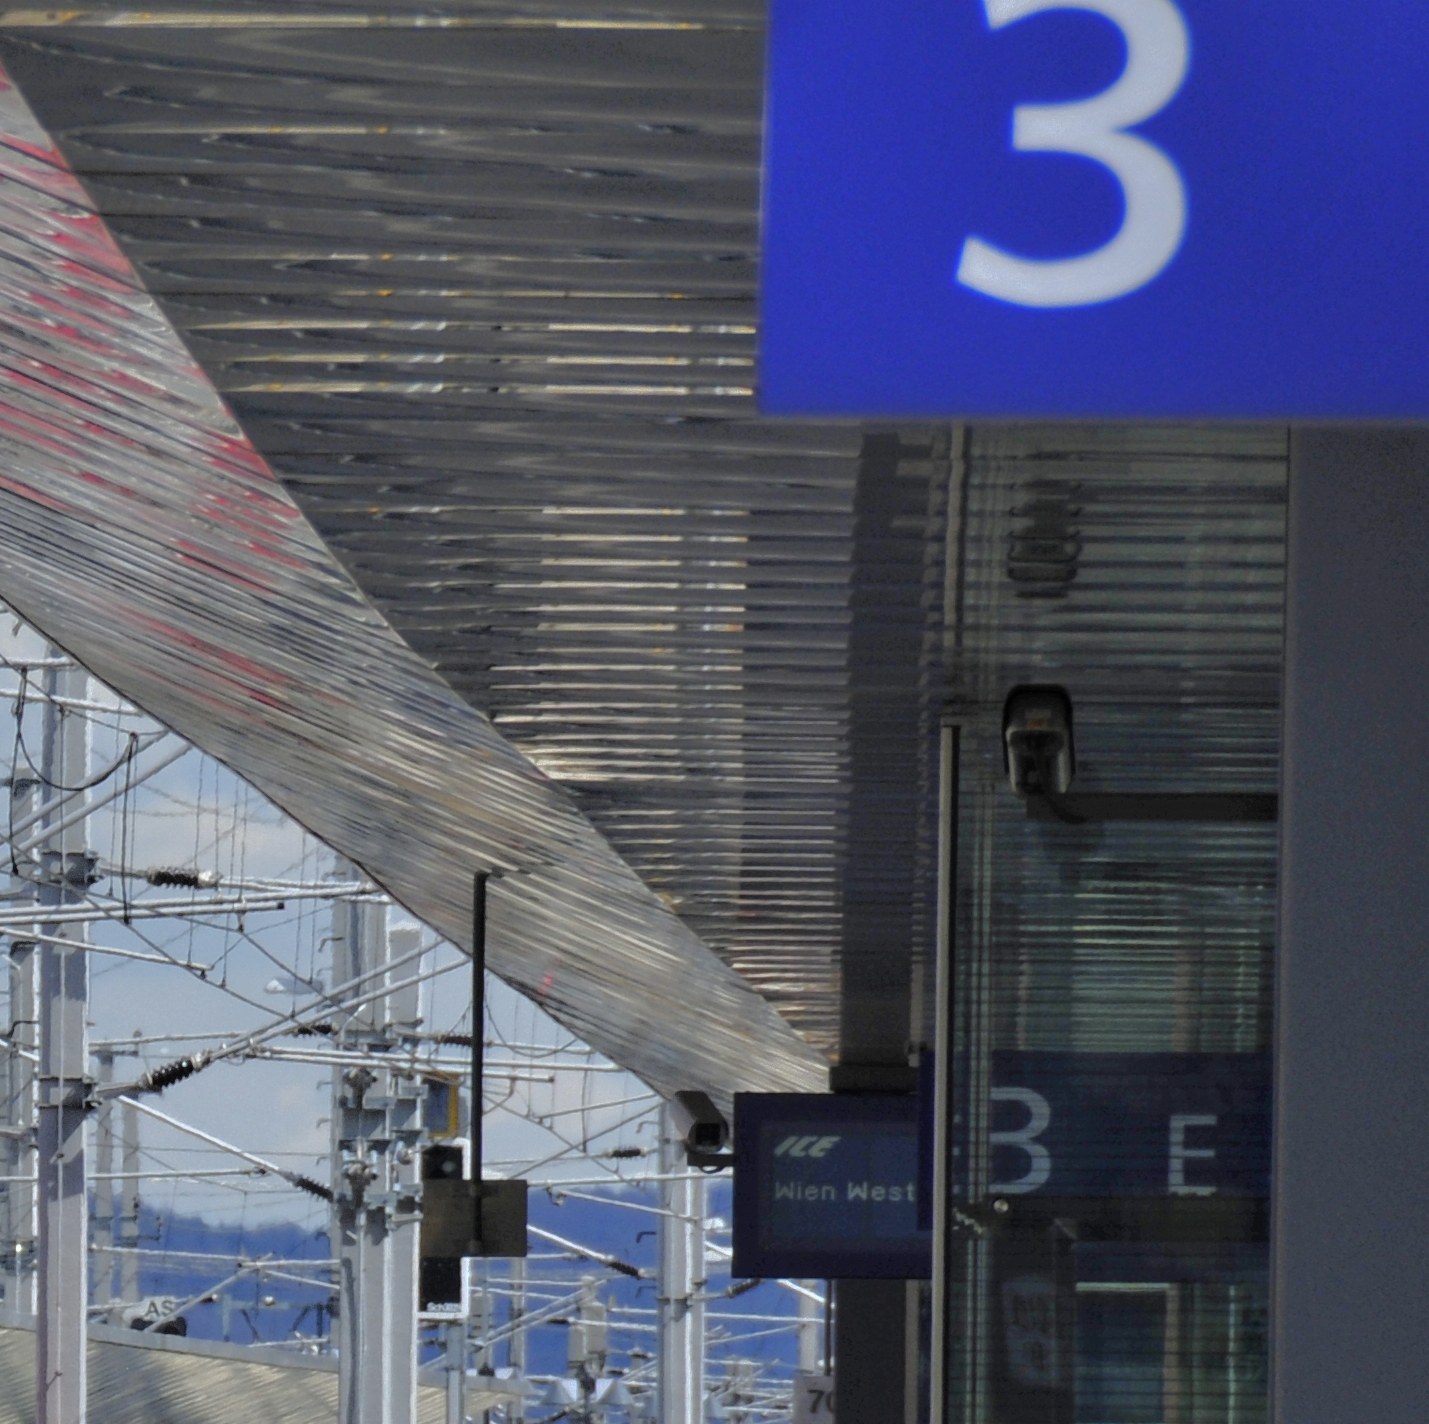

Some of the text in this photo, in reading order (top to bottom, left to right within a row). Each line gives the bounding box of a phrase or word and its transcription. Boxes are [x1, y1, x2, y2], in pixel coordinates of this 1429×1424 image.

[954, 0, 1189, 309] 3
[774, 1135, 841, 1158] ICE
[1168, 1115, 1218, 1196] E
[775, 1181, 836, 1201] Wien
[144, 1299, 174, 1318] AS
